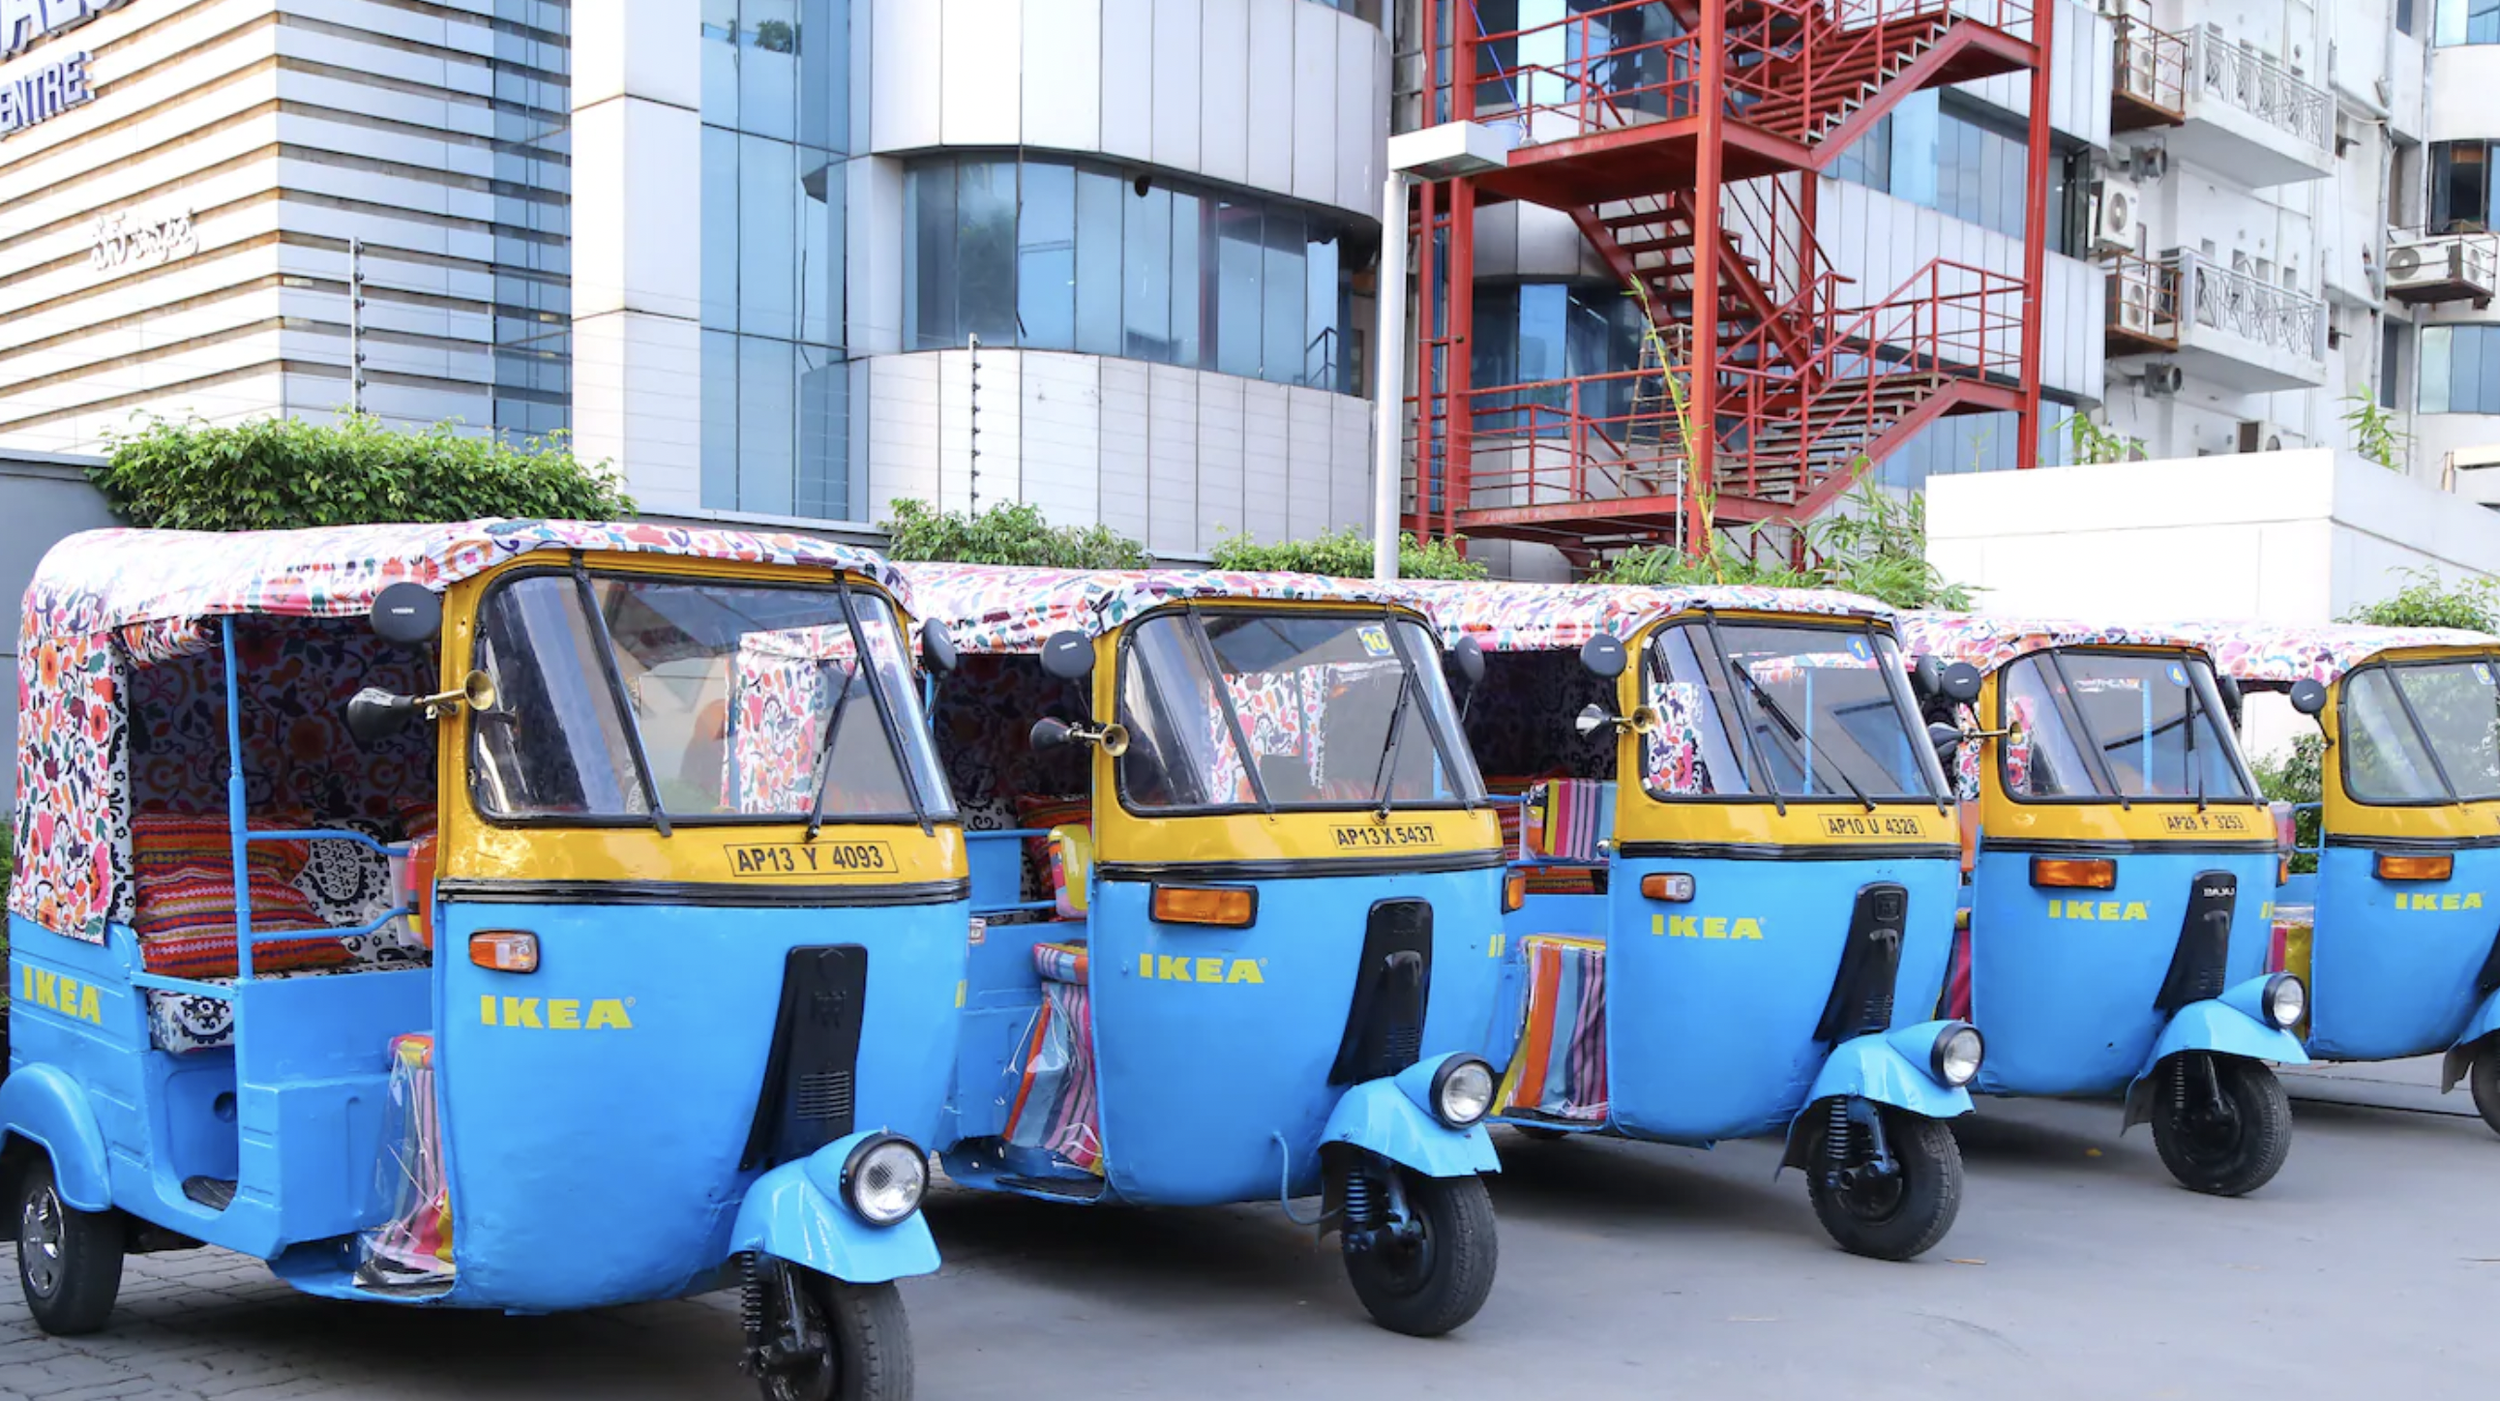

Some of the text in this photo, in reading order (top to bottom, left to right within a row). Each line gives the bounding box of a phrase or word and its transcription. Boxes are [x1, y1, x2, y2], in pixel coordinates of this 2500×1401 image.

[1362, 631, 1389, 650] 10
[1854, 640, 1865, 658] 1
[1337, 826, 1434, 846] AP13 X 5437
[1828, 817, 1918, 836] AP10 U 4328
[737, 845, 884, 872] AP13 Y 4093
[2048, 900, 2148, 920] IKEA
[2396, 892, 2483, 910] IKEA
[1652, 914, 1763, 940] IKEA
[1139, 953, 1264, 984] IKEA
[23, 965, 102, 1025] IKEA
[480, 994, 633, 1030] IKEA
